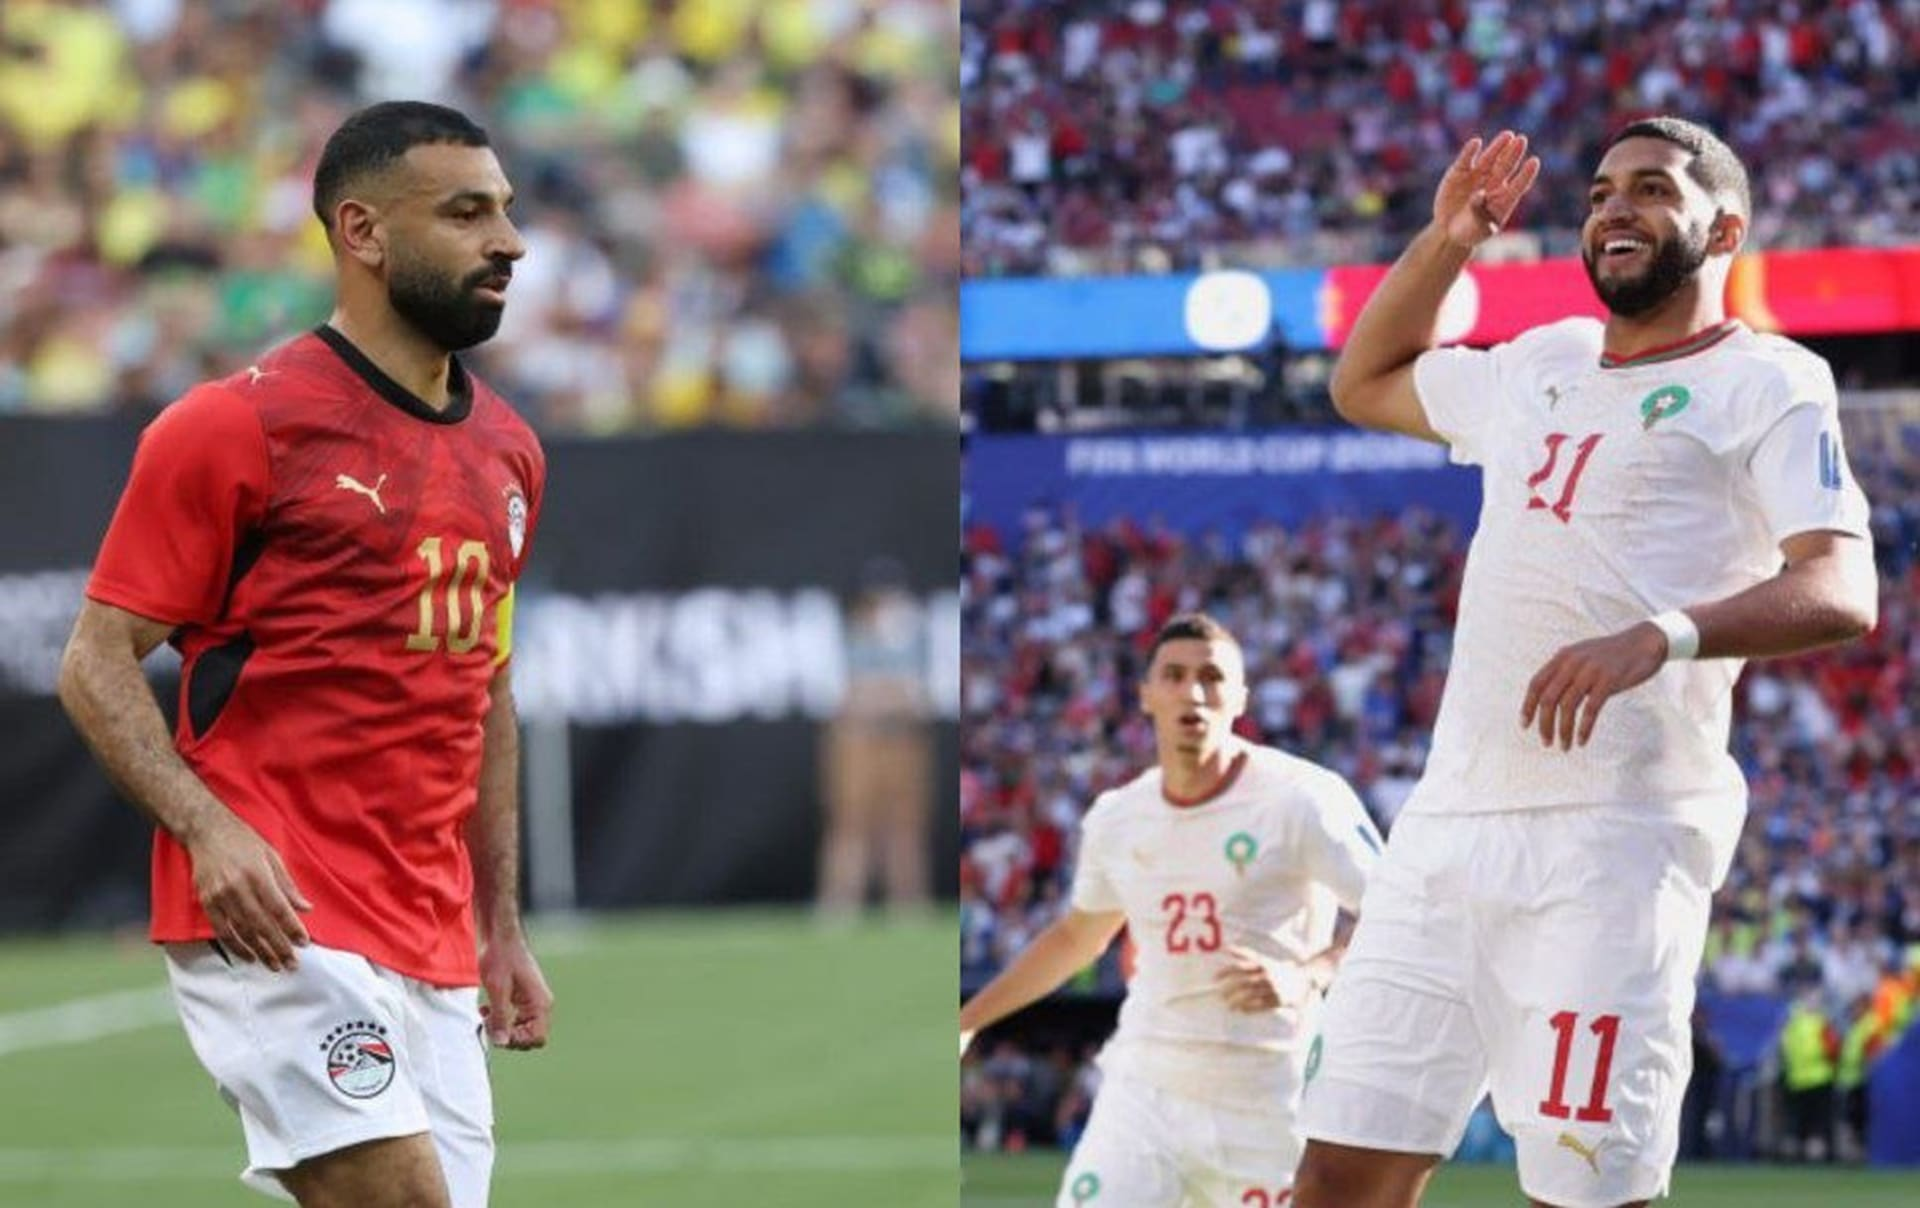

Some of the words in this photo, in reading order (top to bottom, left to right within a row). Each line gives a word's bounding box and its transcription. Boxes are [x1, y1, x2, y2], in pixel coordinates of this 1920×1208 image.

[405, 536, 490, 652] 10
[1161, 892, 1222, 953] 23
[1539, 1010, 1622, 1123] 11
